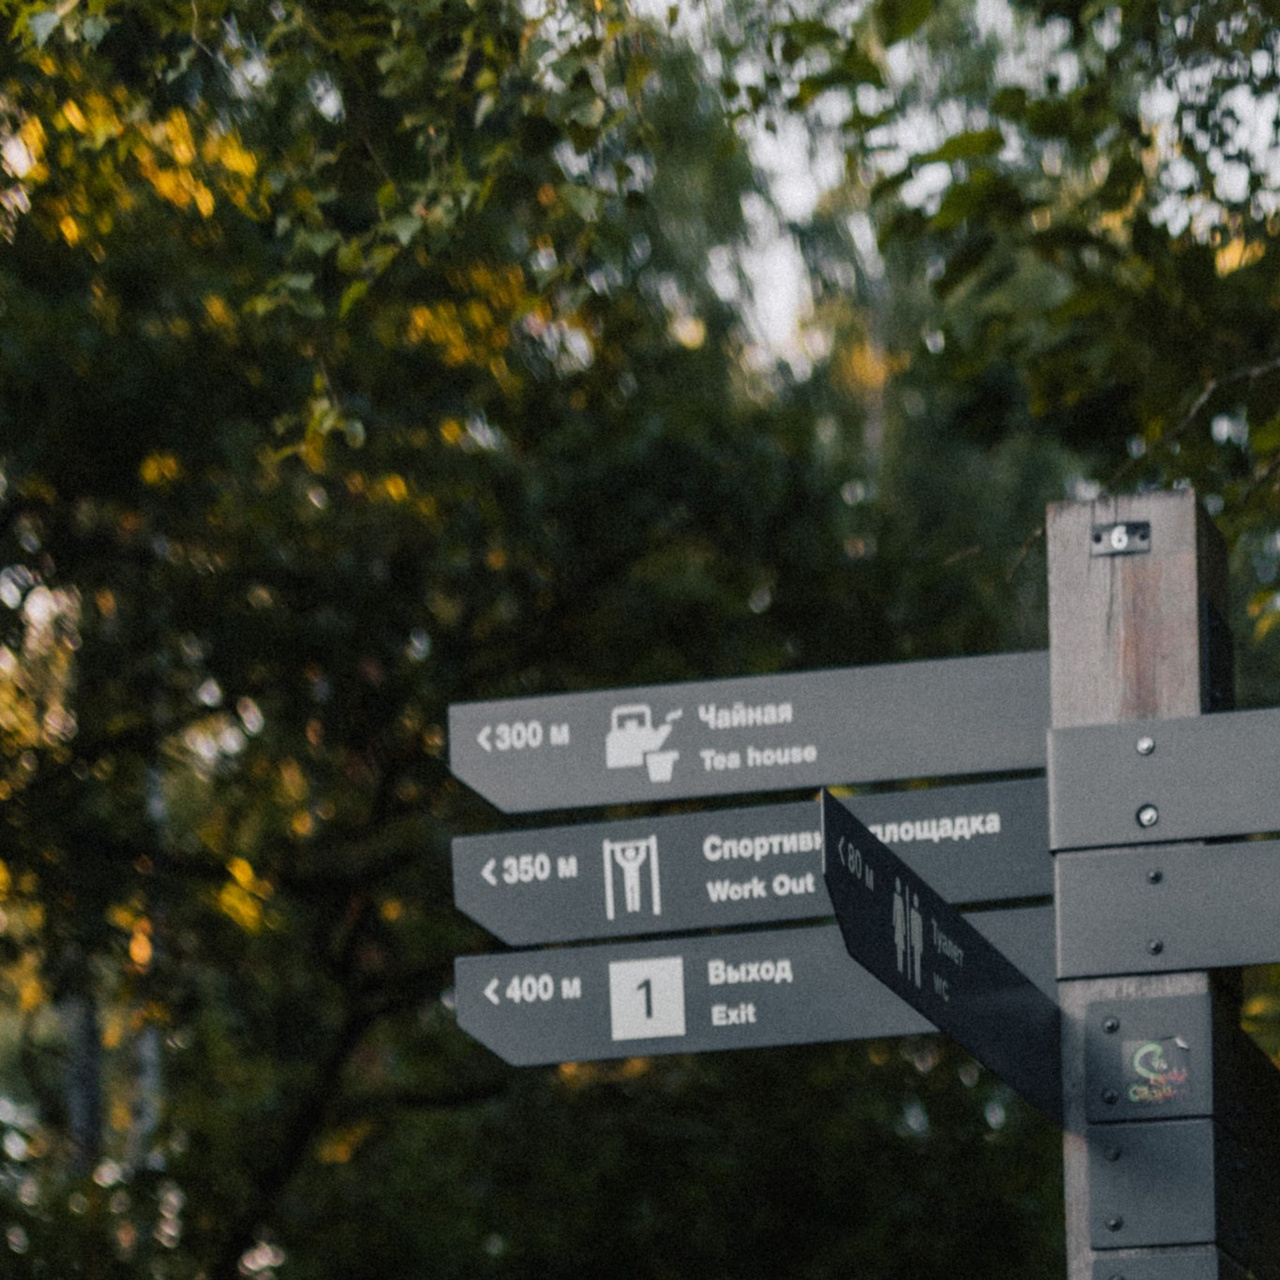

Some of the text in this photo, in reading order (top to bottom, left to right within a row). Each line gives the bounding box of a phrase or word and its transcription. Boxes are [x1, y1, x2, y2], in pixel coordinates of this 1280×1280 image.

[1110, 524, 1129, 550] 6
[697, 702, 794, 730] Чайная
[494, 719, 571, 752] 300 м
[699, 744, 818, 772] Tea house
[701, 829, 821, 863] Спортивн
[502, 852, 579, 885] 350 м
[847, 842, 875, 892] 80 м
[705, 872, 816, 903] Work Out
[931, 917, 965, 969] Туалет
[706, 958, 794, 986] Выход
[933, 971, 950, 1004] WC
[504, 973, 582, 1004] 400 м
[636, 977, 654, 1020] 1
[710, 1002, 757, 1027] Exit
